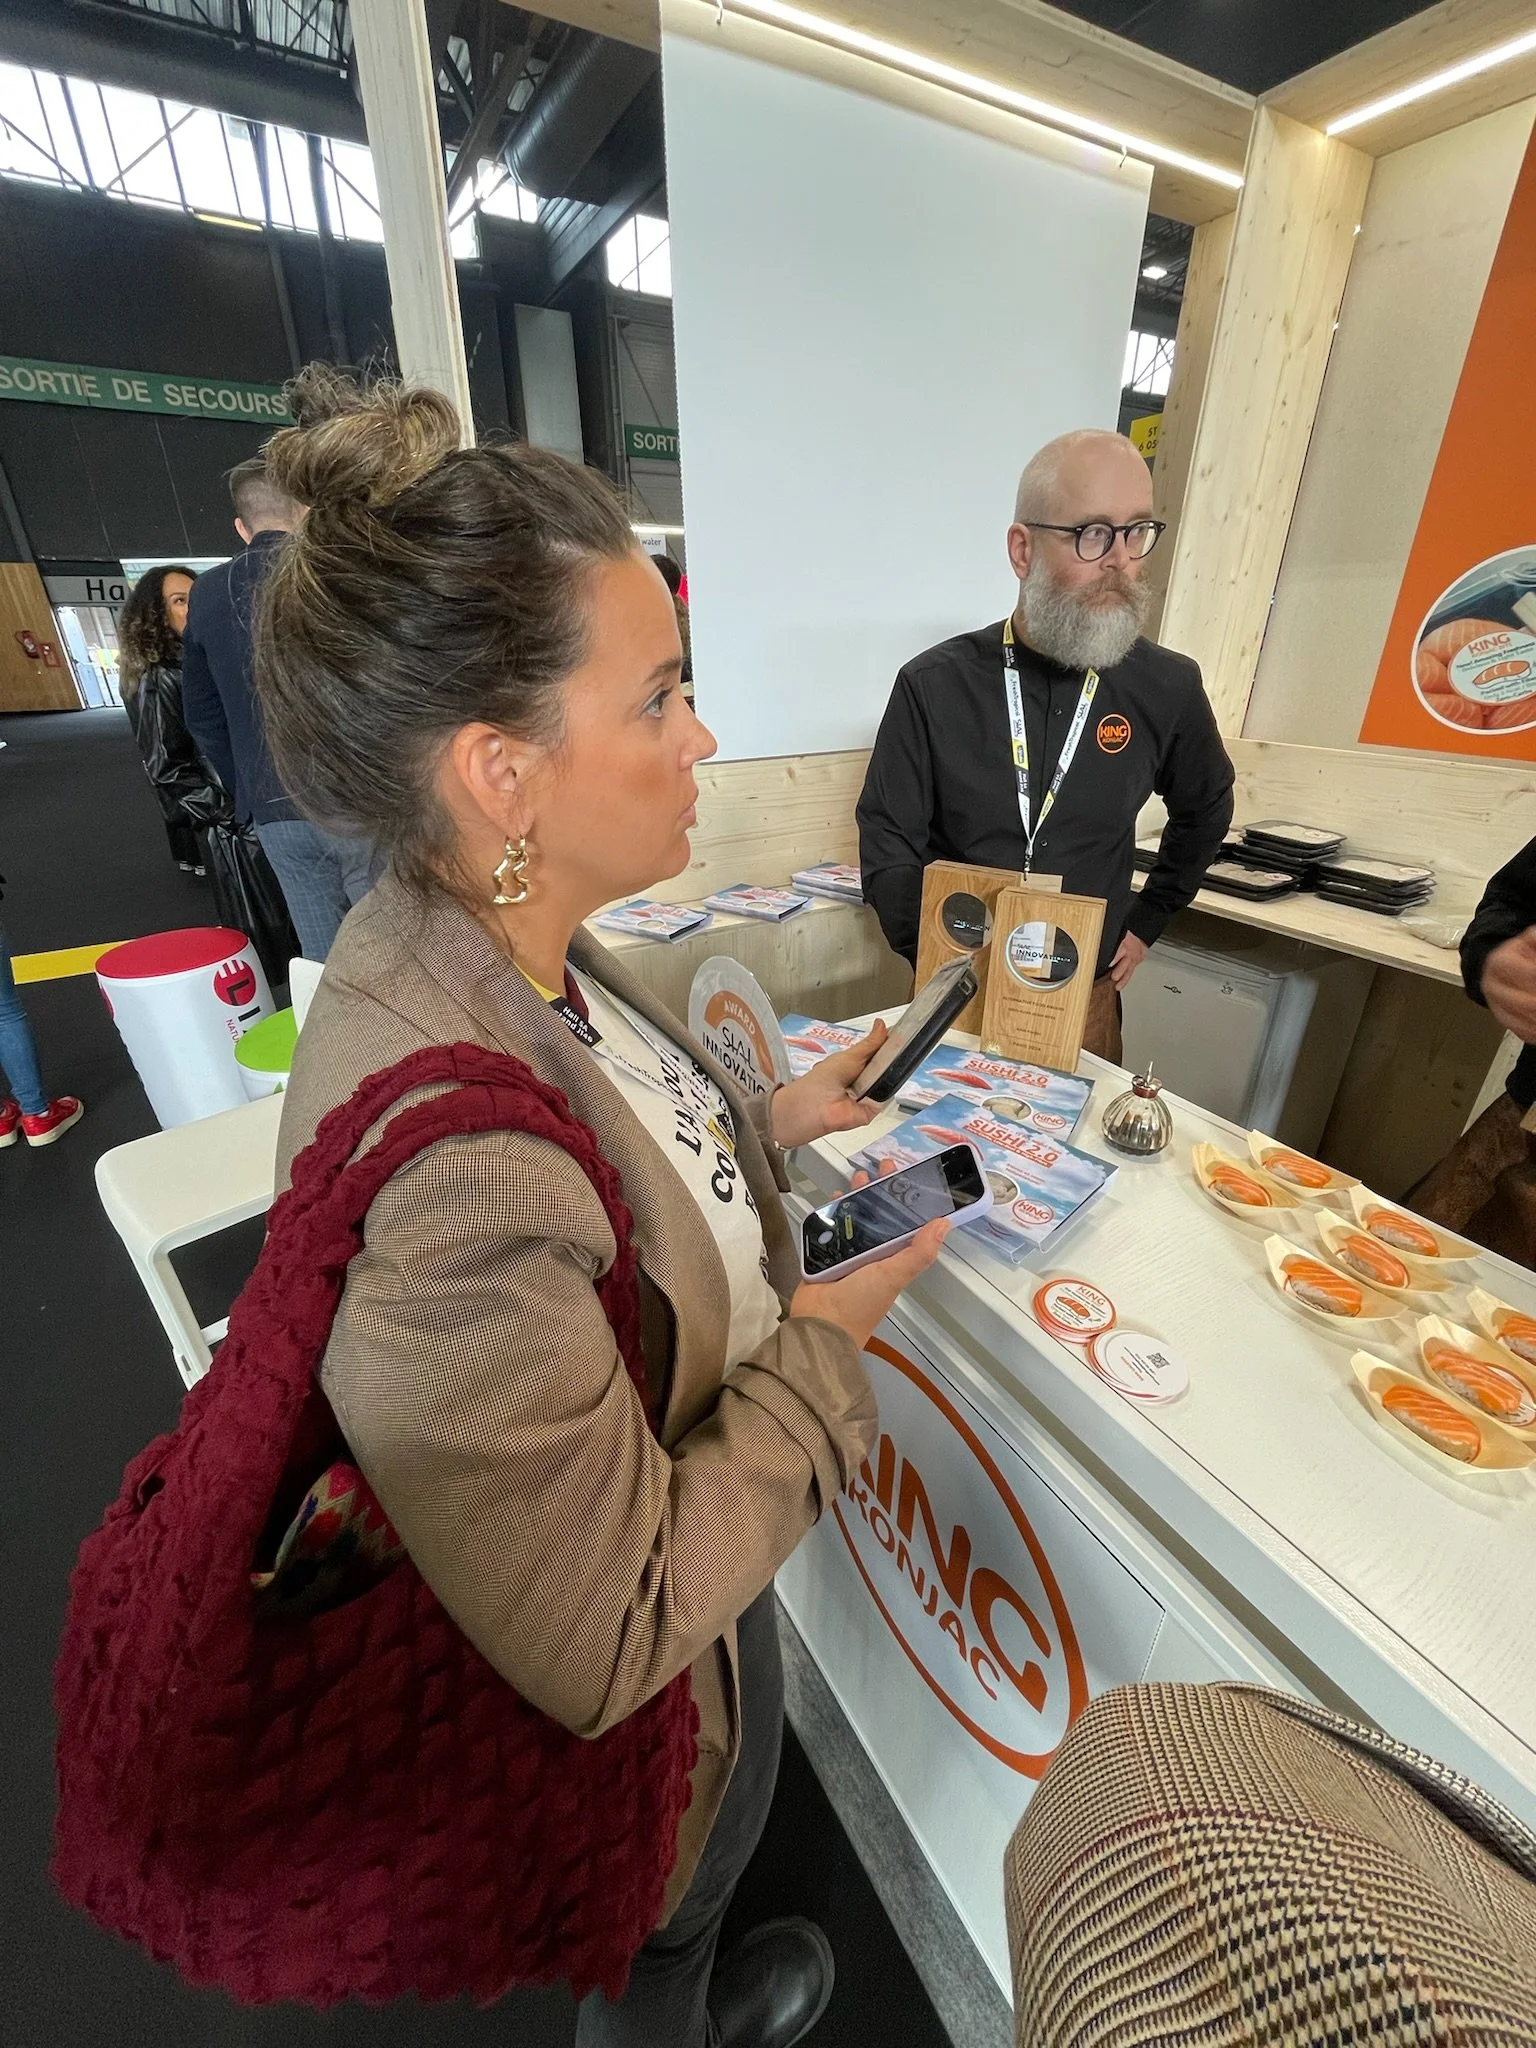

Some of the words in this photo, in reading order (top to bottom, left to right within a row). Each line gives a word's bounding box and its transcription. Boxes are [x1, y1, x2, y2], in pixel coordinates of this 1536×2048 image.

[0, 365, 101, 398] SORTIE
[112, 378, 152, 403] DE
[163, 383, 288, 417] SECOURS
[1467, 633, 1511, 654] KING
[1100, 725, 1127, 738] KING
[562, 1006, 579, 1022] Hall
[724, 1000, 756, 1035] AWARD
[810, 1027, 854, 1045] SUSHI
[967, 1059, 1019, 1080] SUSHI
[1021, 1070, 1049, 1086] 2.0
[1036, 1113, 1064, 1126] KING
[969, 1119, 1026, 1148] SUSHI
[1026, 1143, 1059, 1162] 2.0
[1018, 1200, 1050, 1220] KING
[1077, 1286, 1106, 1306] KING
[860, 1433, 1051, 1714] ING
[848, 1477, 1000, 1701] KONJAC
